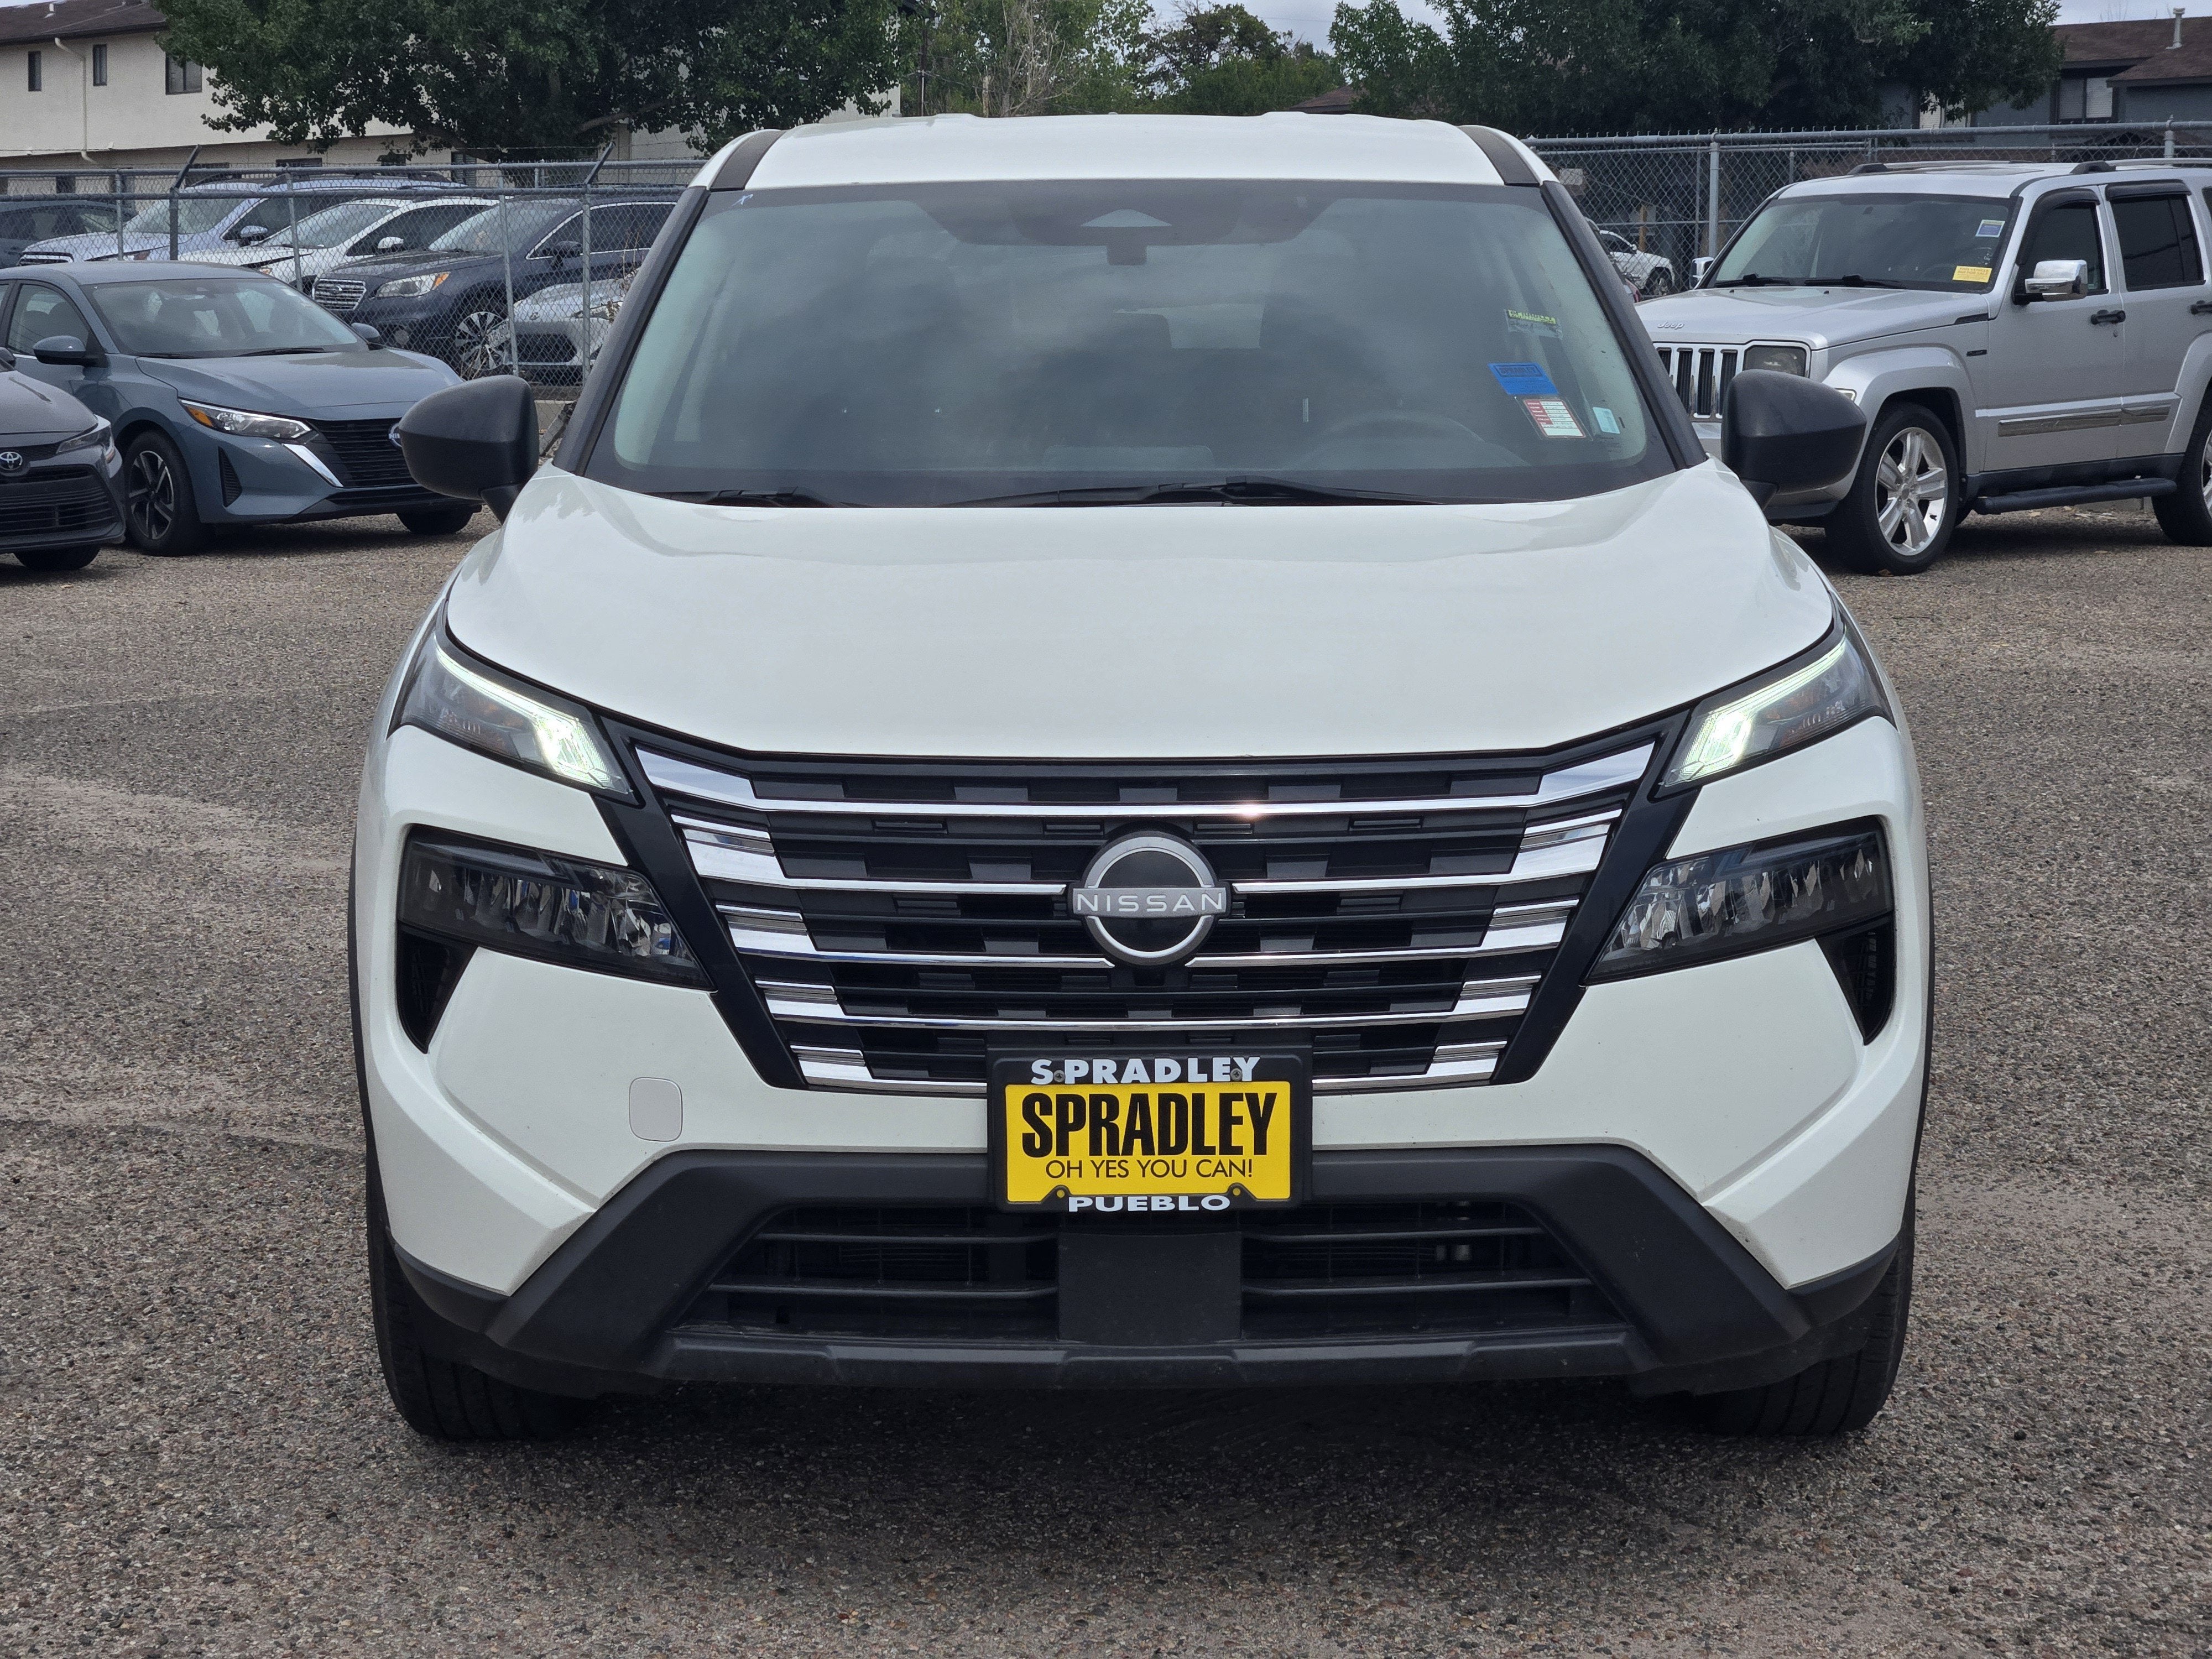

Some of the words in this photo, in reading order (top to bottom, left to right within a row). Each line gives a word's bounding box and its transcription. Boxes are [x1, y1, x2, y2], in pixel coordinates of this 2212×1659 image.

[1657, 321, 1685, 330] Jeep
[1077, 893, 1222, 912] NISSAN
[1031, 1056, 1261, 1085] SPRADLEY
[1021, 1092, 1279, 1158] SPRADLEY
[1045, 1160, 1083, 1178] OH
[1091, 1160, 1129, 1178] YES
[1136, 1159, 1187, 1178] YOU
[1196, 1159, 1253, 1178] CAN!
[1068, 1194, 1231, 1212] PUEBLO
